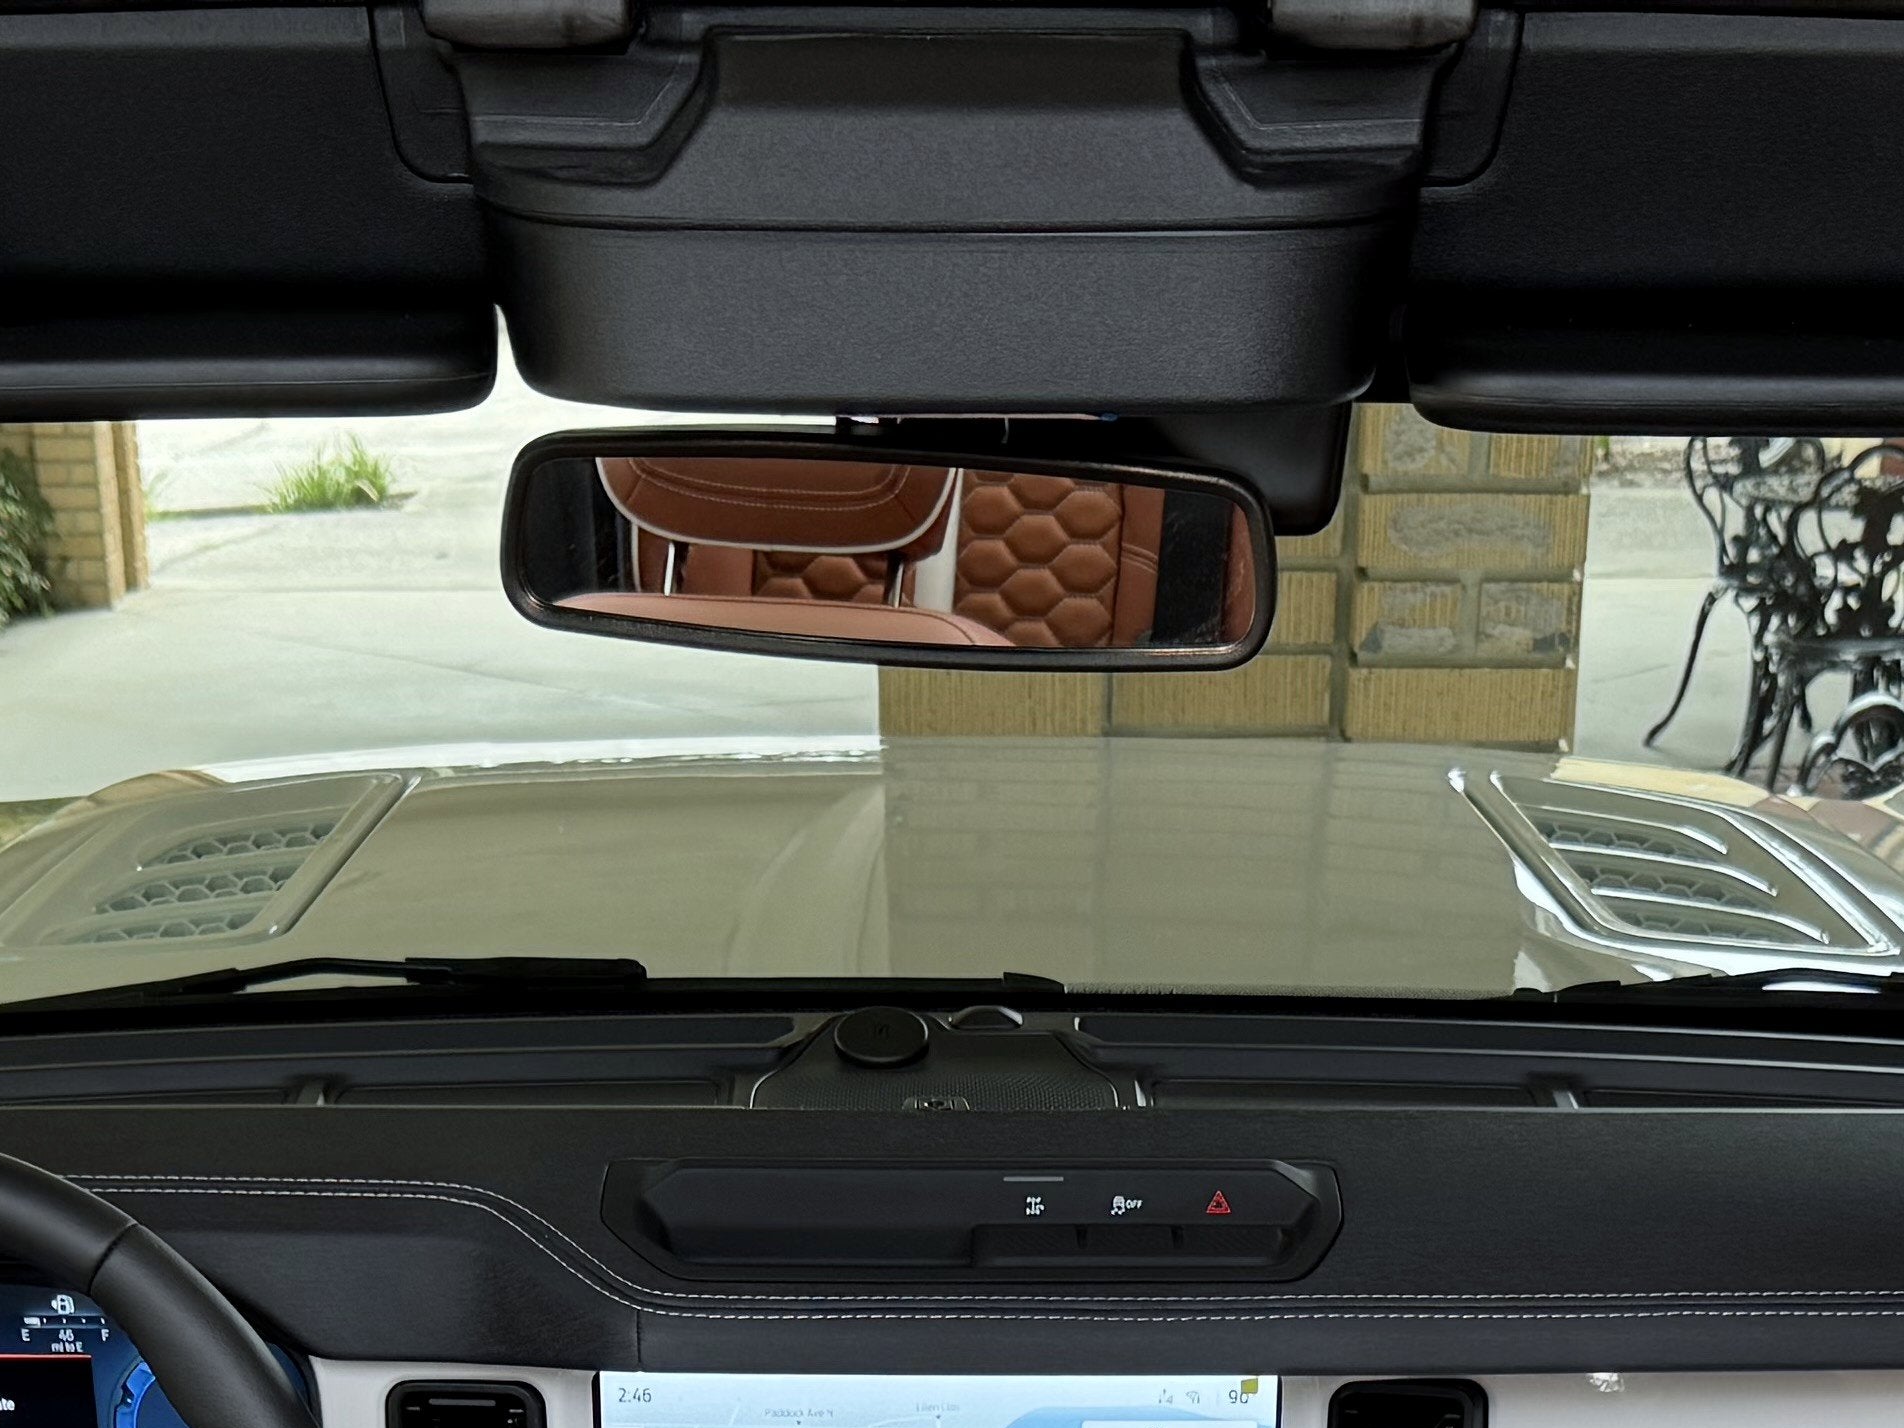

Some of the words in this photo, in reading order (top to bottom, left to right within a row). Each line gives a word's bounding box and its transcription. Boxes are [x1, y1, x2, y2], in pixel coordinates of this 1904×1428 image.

[1126, 1199, 1143, 1209] OFF
[21, 1329, 30, 1341] E
[101, 1329, 110, 1341] F
[618, 1387, 652, 1403] 2:46
